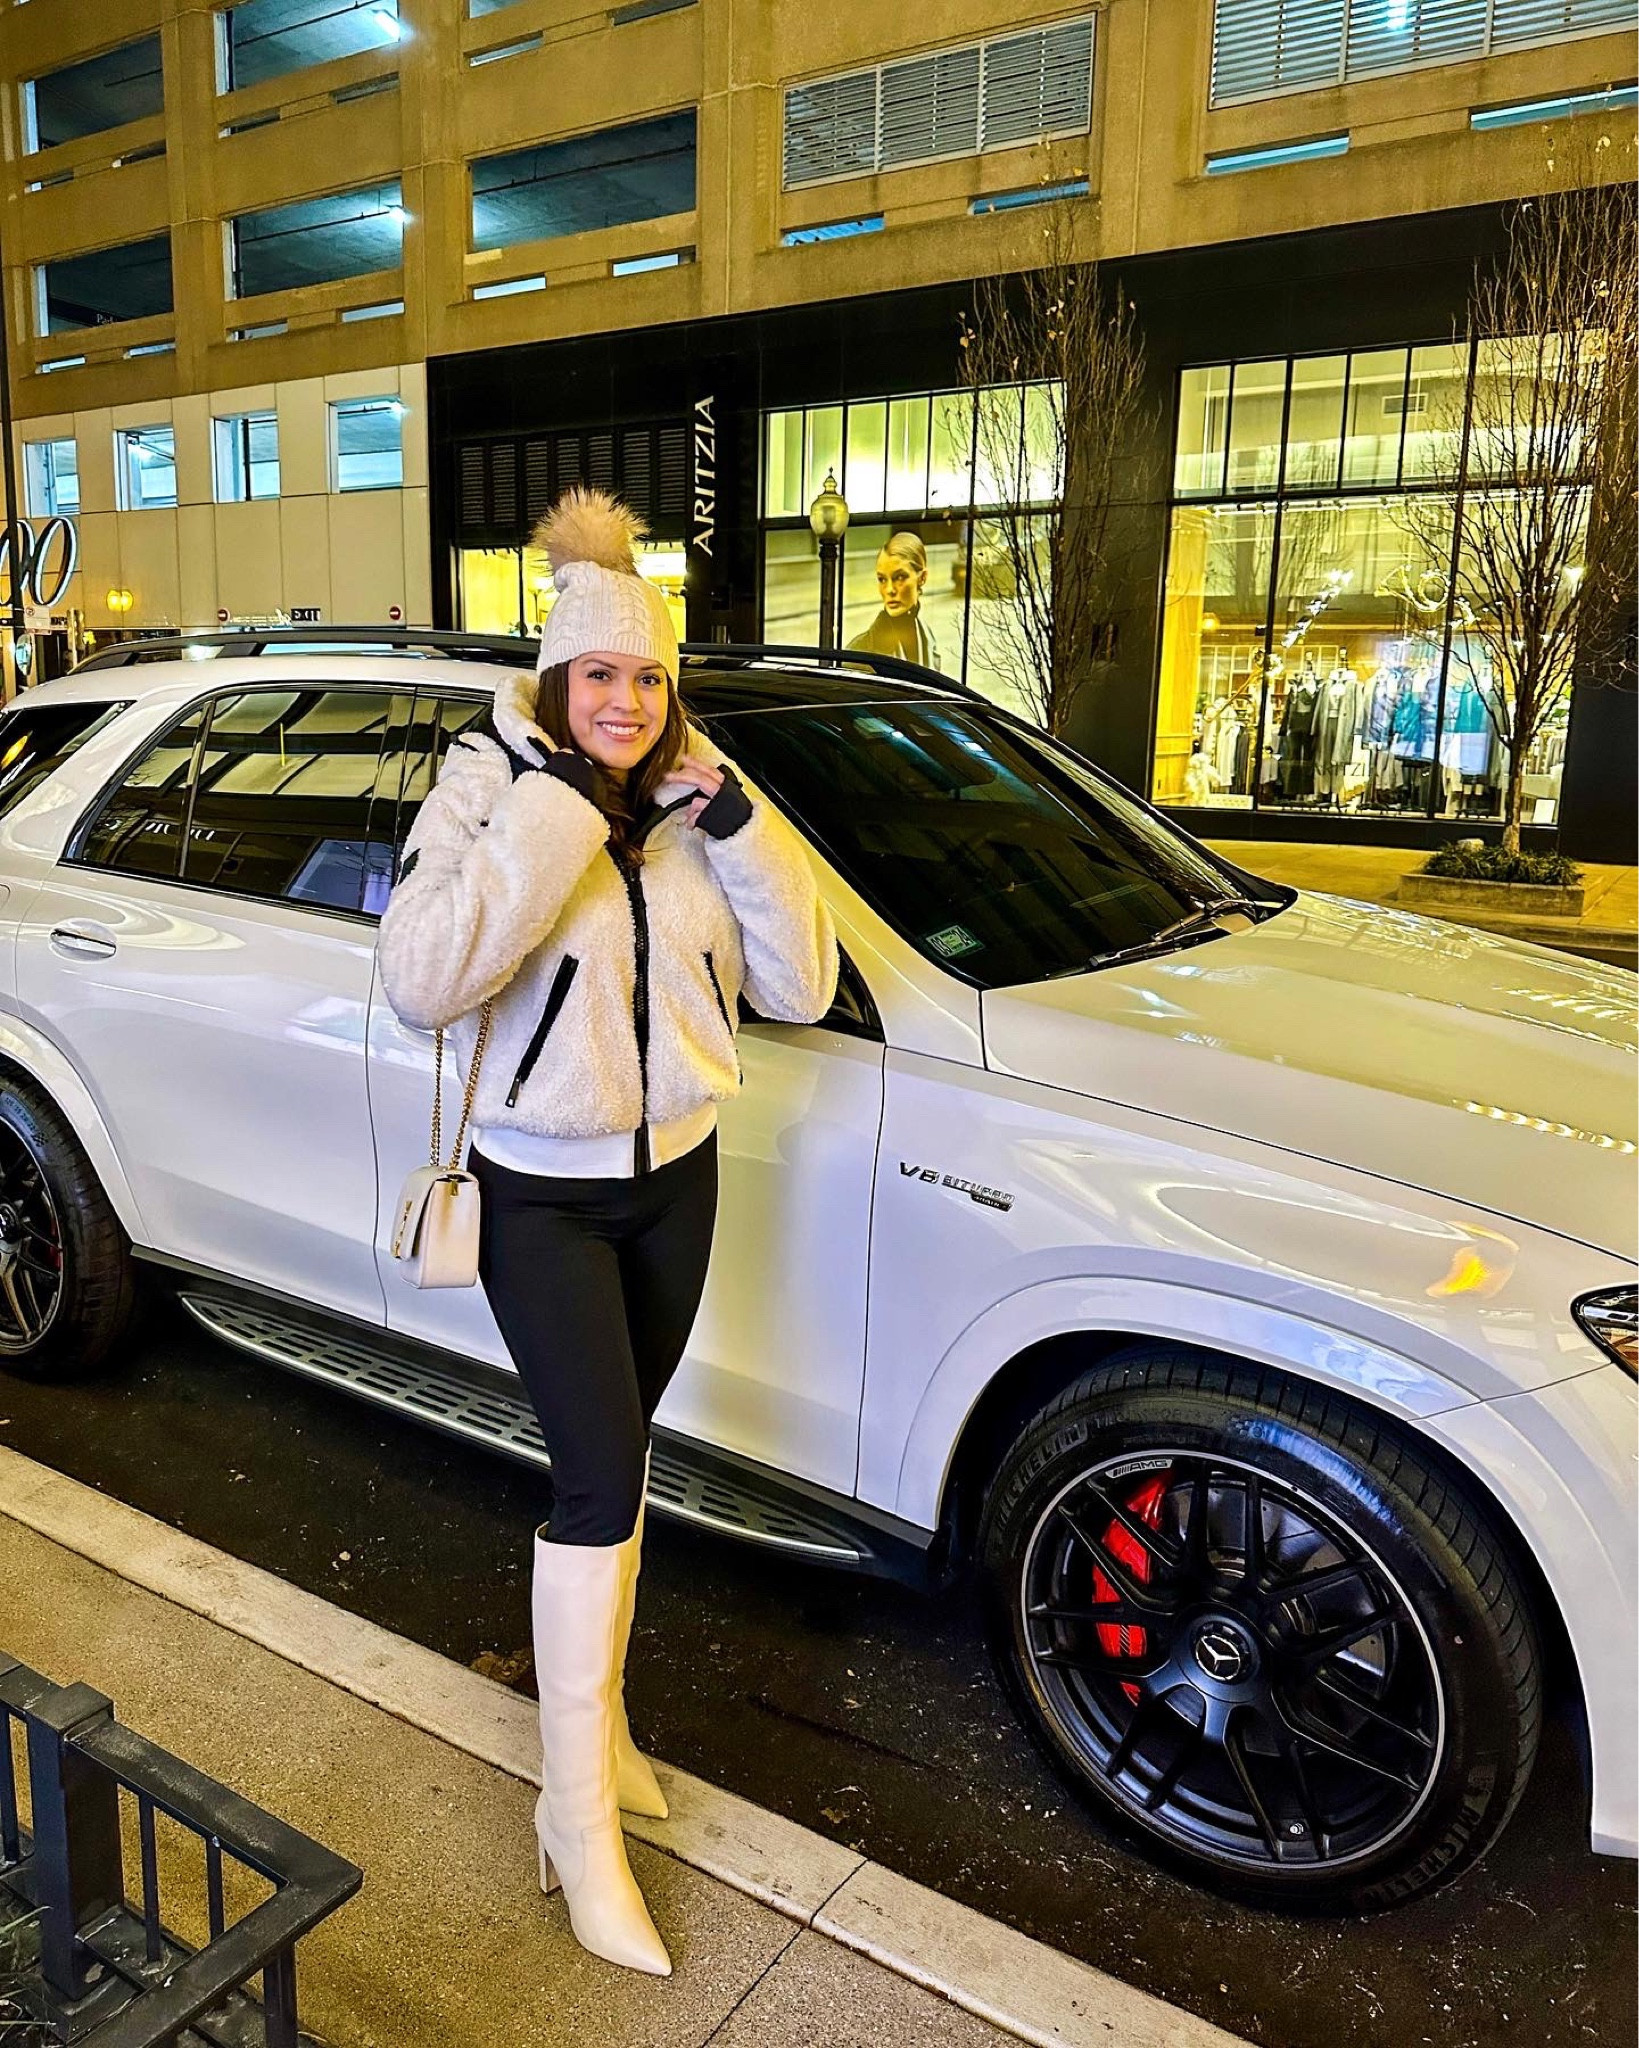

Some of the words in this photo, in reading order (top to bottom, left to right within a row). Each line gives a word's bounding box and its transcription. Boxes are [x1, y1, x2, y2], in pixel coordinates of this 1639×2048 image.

[692, 395, 716, 559] ARITZIA
[291, 608, 321, 621] EXIT
[899, 1161, 940, 1185] V8
[943, 1174, 1015, 1202] BITURBO
[998, 1419, 1087, 1527] MICHELIN
[1130, 1460, 1168, 1471] AMG
